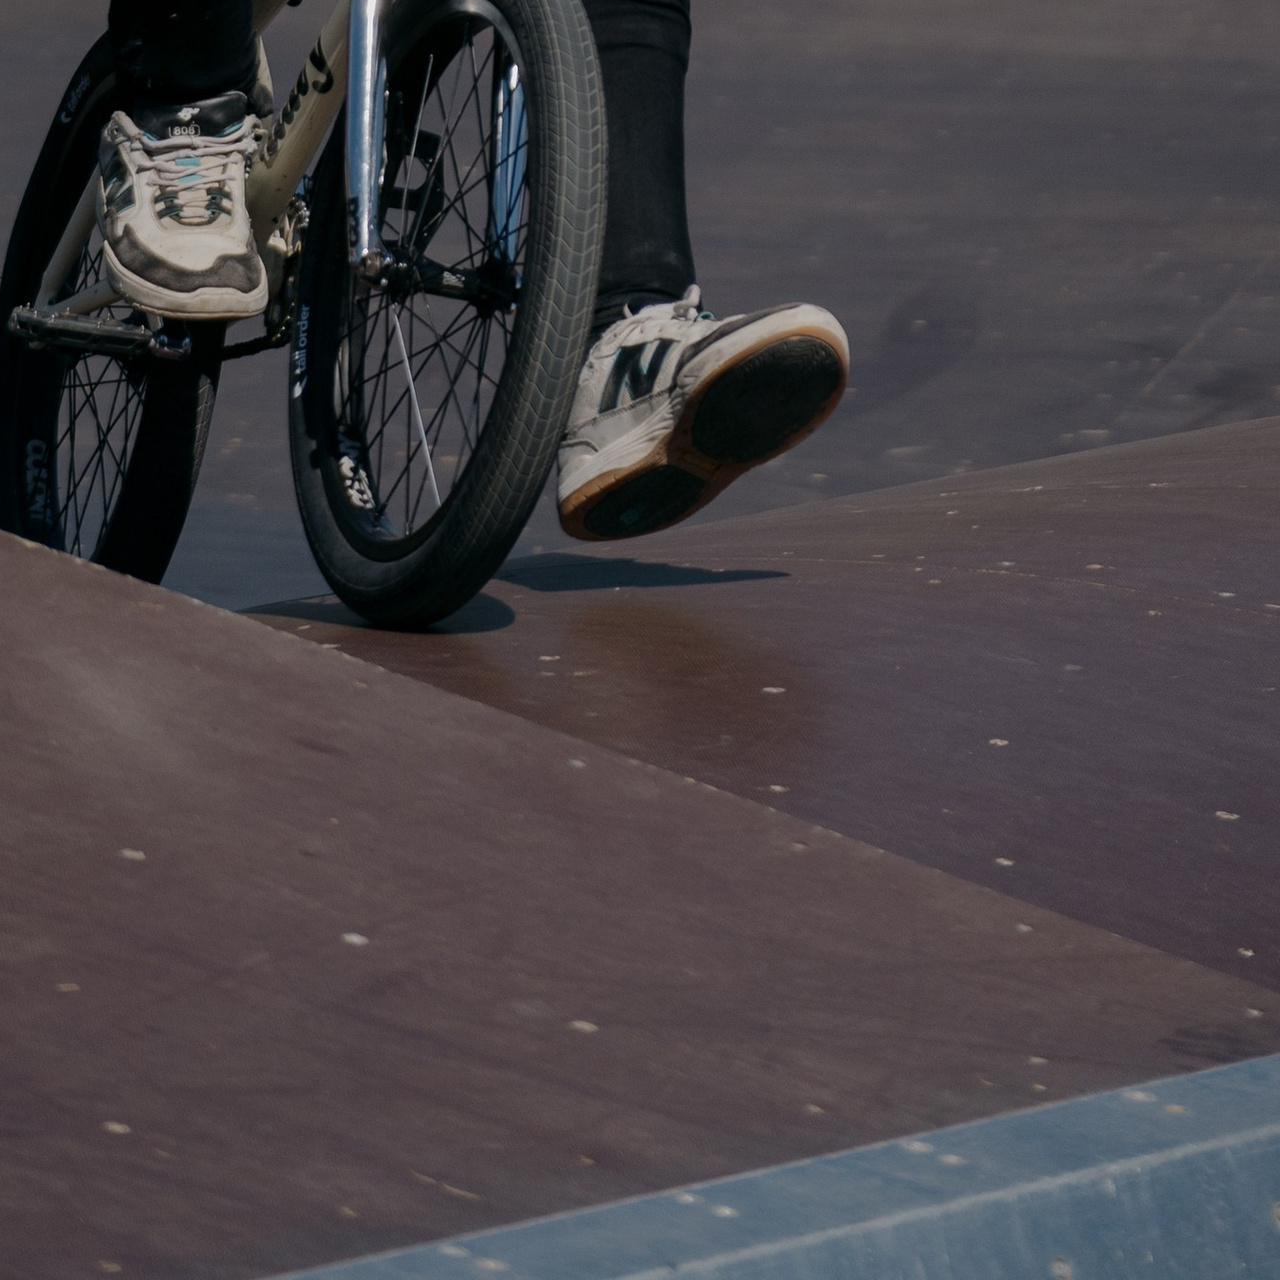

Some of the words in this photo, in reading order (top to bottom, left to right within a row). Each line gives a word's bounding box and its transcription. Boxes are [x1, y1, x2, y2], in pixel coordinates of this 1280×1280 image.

[173, 125, 196, 136] 808
[296, 303, 310, 348] order
[291, 349, 307, 375] tall
